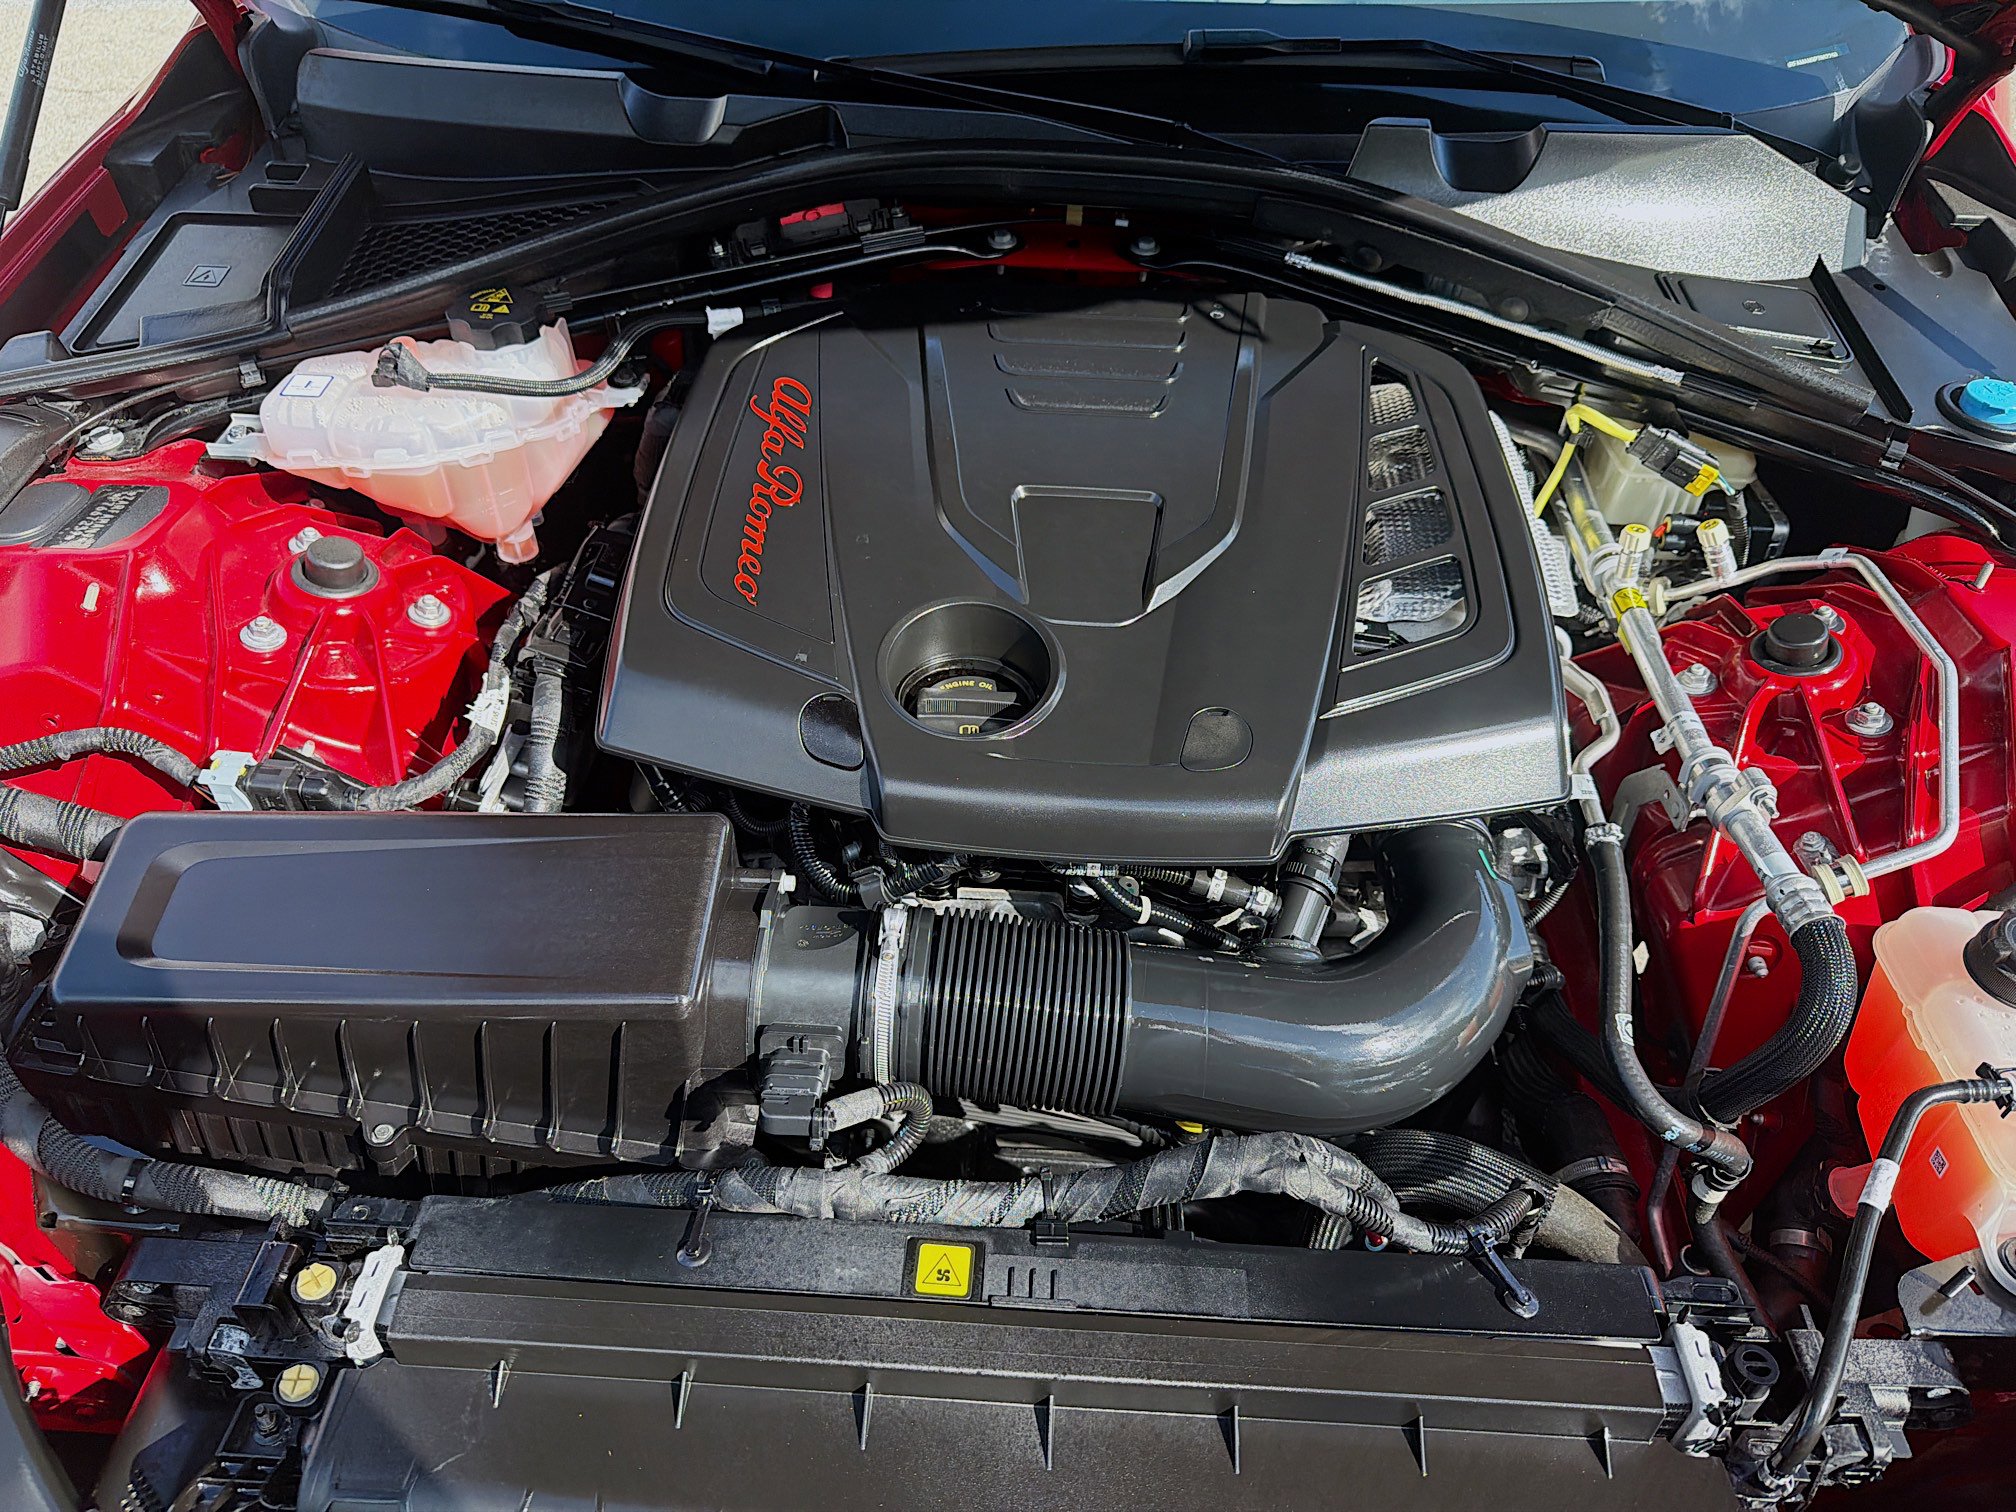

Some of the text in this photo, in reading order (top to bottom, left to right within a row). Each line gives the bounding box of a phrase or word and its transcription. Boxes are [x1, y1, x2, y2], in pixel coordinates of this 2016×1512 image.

[30, 33, 44, 75] STABILUS
[733, 376, 812, 607] Alfa Romeo
[939, 680, 993, 691] ENGINE OIL
